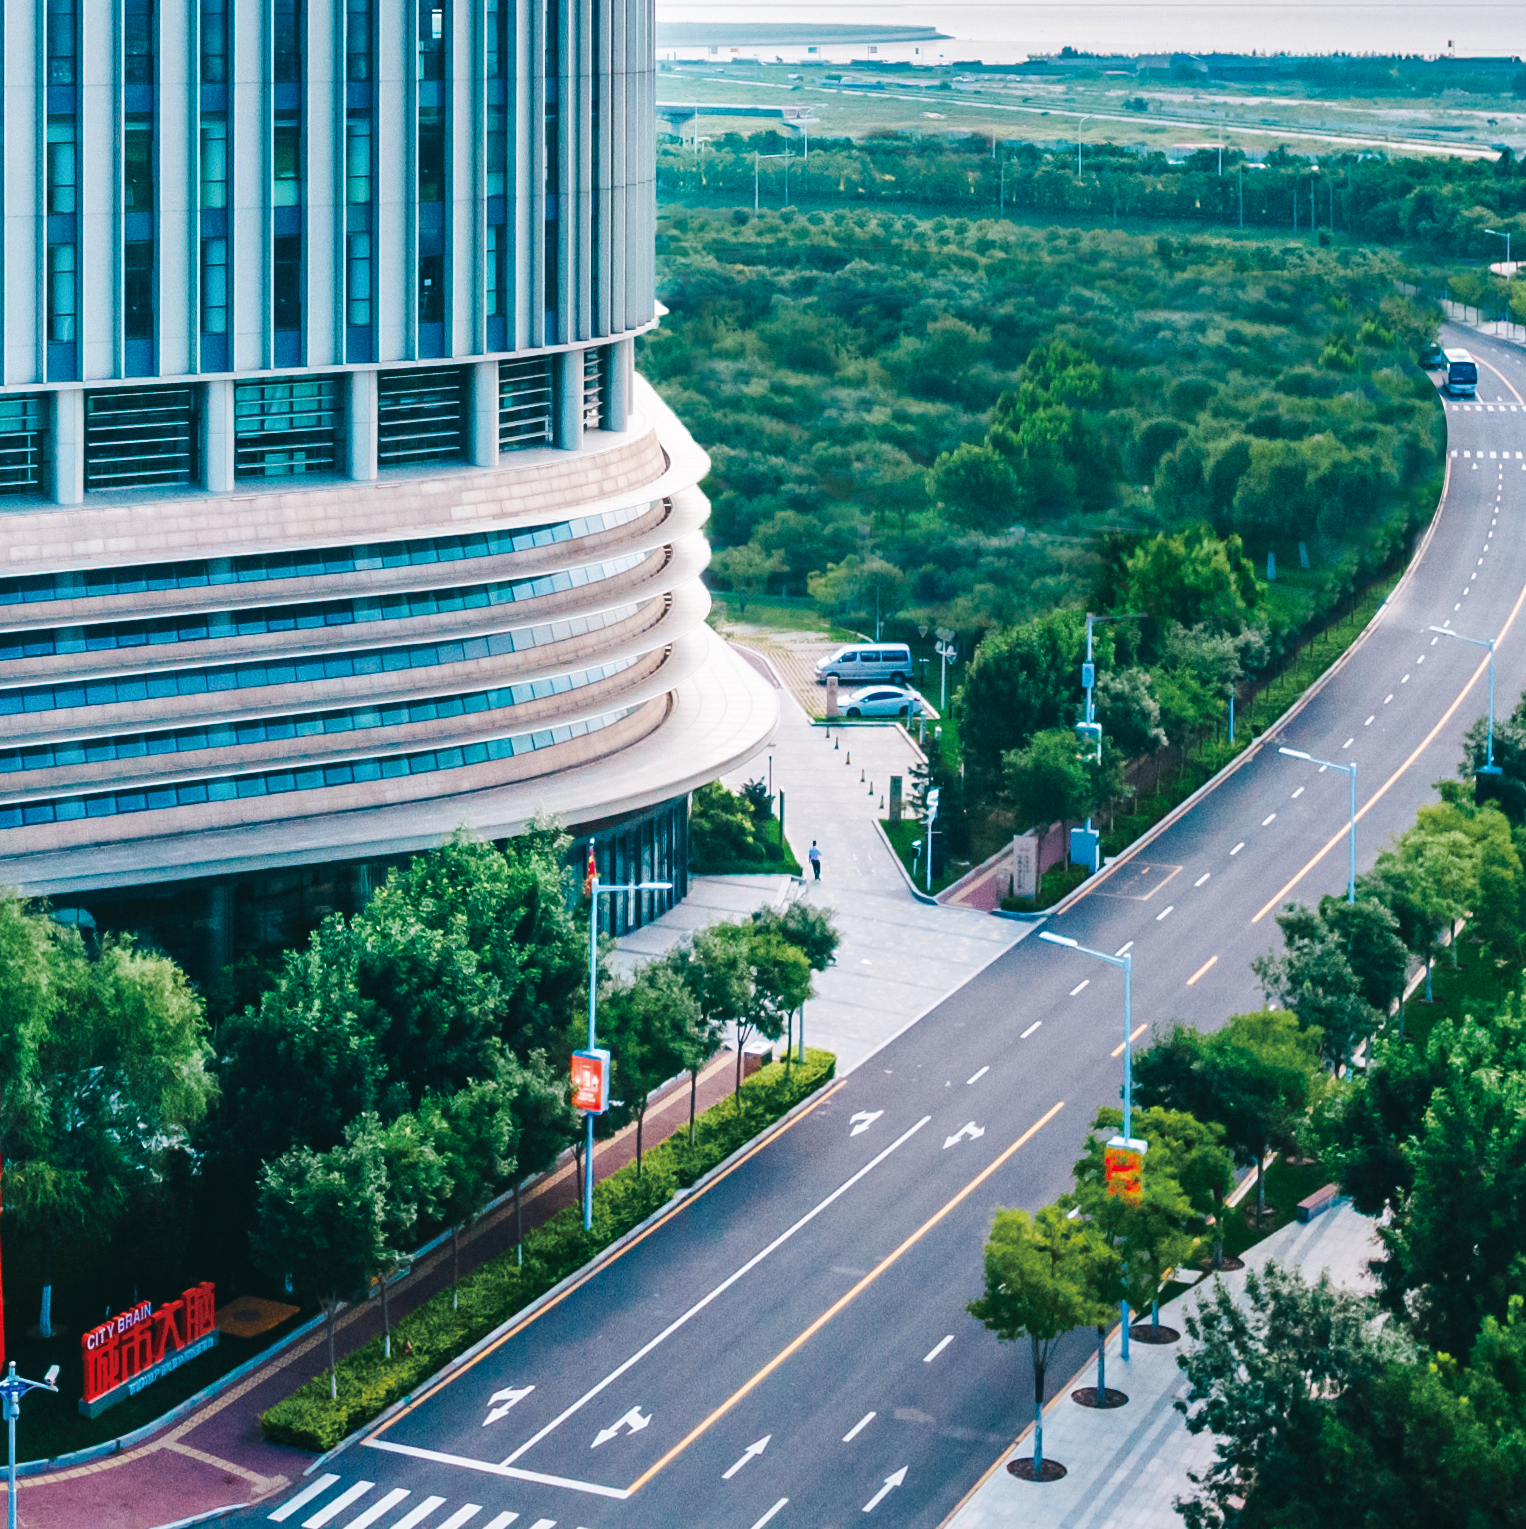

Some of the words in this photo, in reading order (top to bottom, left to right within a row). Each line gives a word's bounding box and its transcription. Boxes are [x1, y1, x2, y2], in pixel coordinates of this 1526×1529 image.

[83, 1282, 215, 1403] 城市大脑
[87, 1322, 115, 1350] CITY
[118, 1302, 152, 1334] BRAIN
